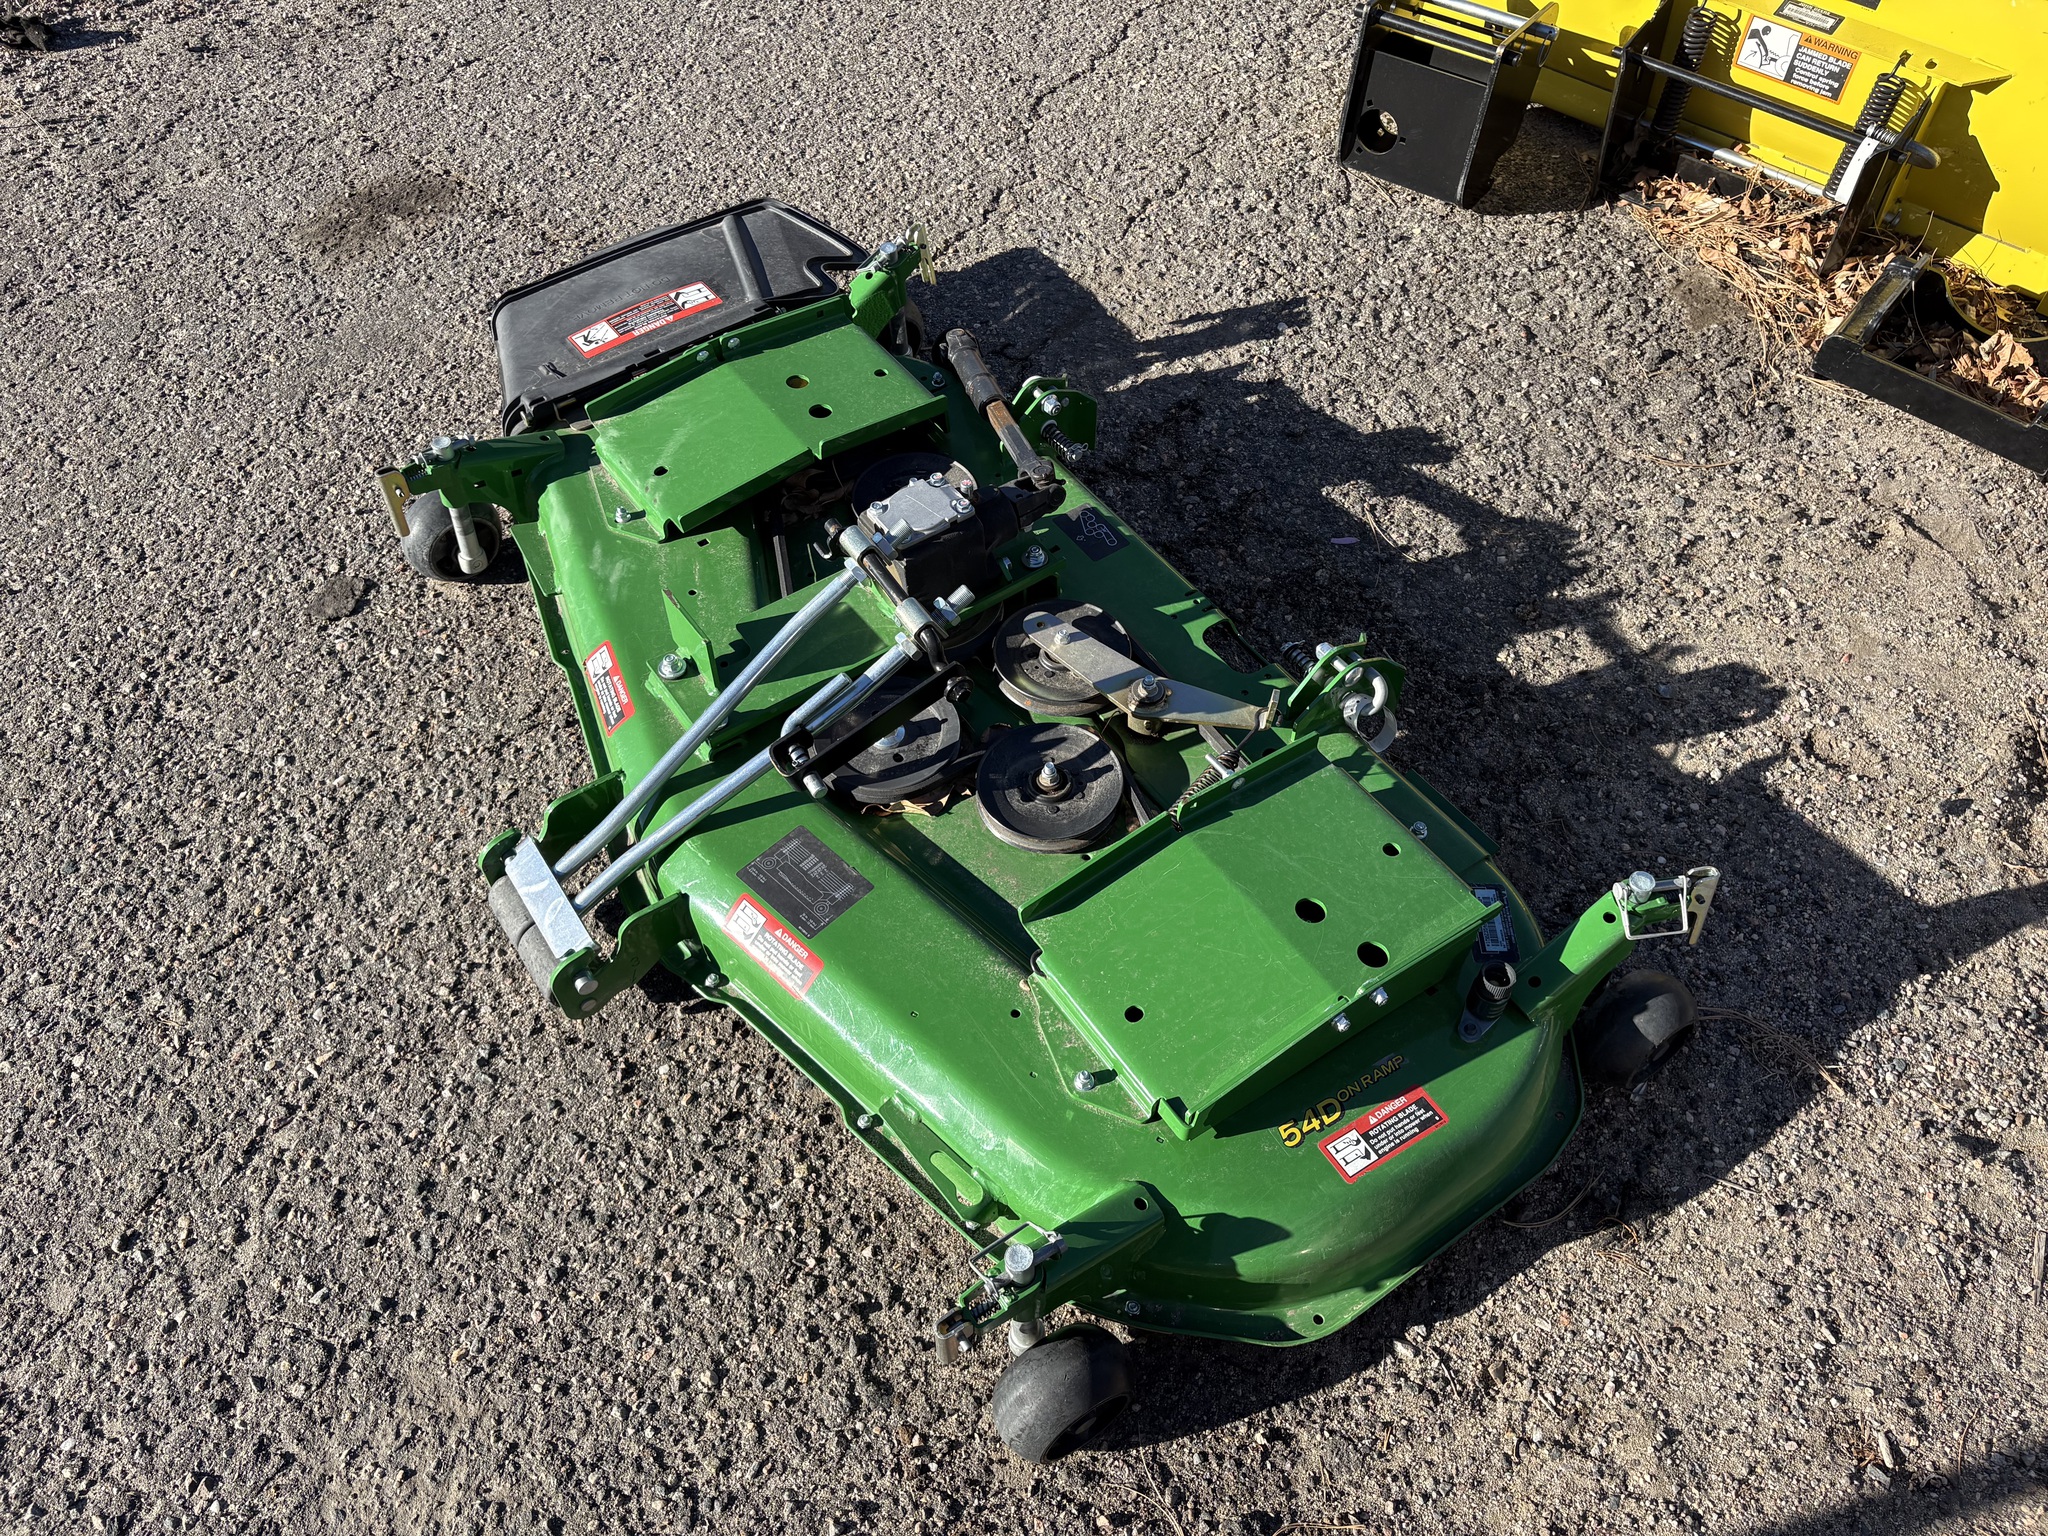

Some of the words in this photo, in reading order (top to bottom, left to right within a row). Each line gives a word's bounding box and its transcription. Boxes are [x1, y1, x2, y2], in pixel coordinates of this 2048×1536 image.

[1798, 46, 1828, 61] JAMMED
[1828, 56, 1853, 70] BLADE
[1814, 37, 1859, 60] WARNING
[1793, 59, 1830, 77] SUDDENLY
[1796, 53, 1811, 63] CAN
[1811, 58, 1840, 73] RETURN
[1790, 79, 1819, 94] removing
[1792, 73, 1809, 83] force
[1809, 79, 1830, 91] before
[1795, 67, 1818, 80] Control
[1818, 76, 1839, 89] spring
[631, 319, 667, 336] DANGER
[615, 680, 629, 705] DANGER
[763, 931, 789, 957] ROTATING
[786, 952, 804, 971] BLADE
[781, 932, 809, 960] DANGER
[1278, 1096, 1344, 1148] 54D
[1336, 1080, 1361, 1102] ON
[1360, 1055, 1405, 1088] RAMP
[1374, 1095, 1408, 1120] DANGER
[1368, 1115, 1399, 1137] ROTATING
[1397, 1103, 1419, 1119] BLADE
[1369, 1137, 1378, 1146] Do
[1378, 1132, 1387, 1141] not
[1386, 1126, 1396, 1136] put
[1394, 1117, 1410, 1130] hands
[1414, 1107, 1426, 1118] feet
[1373, 1138, 1389, 1150] under
[1393, 1128, 1405, 1138] into
[1404, 1118, 1420, 1131] mower
[1420, 1110, 1434, 1121] when
[1377, 1141, 1395, 1155] engine
[1399, 1126, 1420, 1141] running
